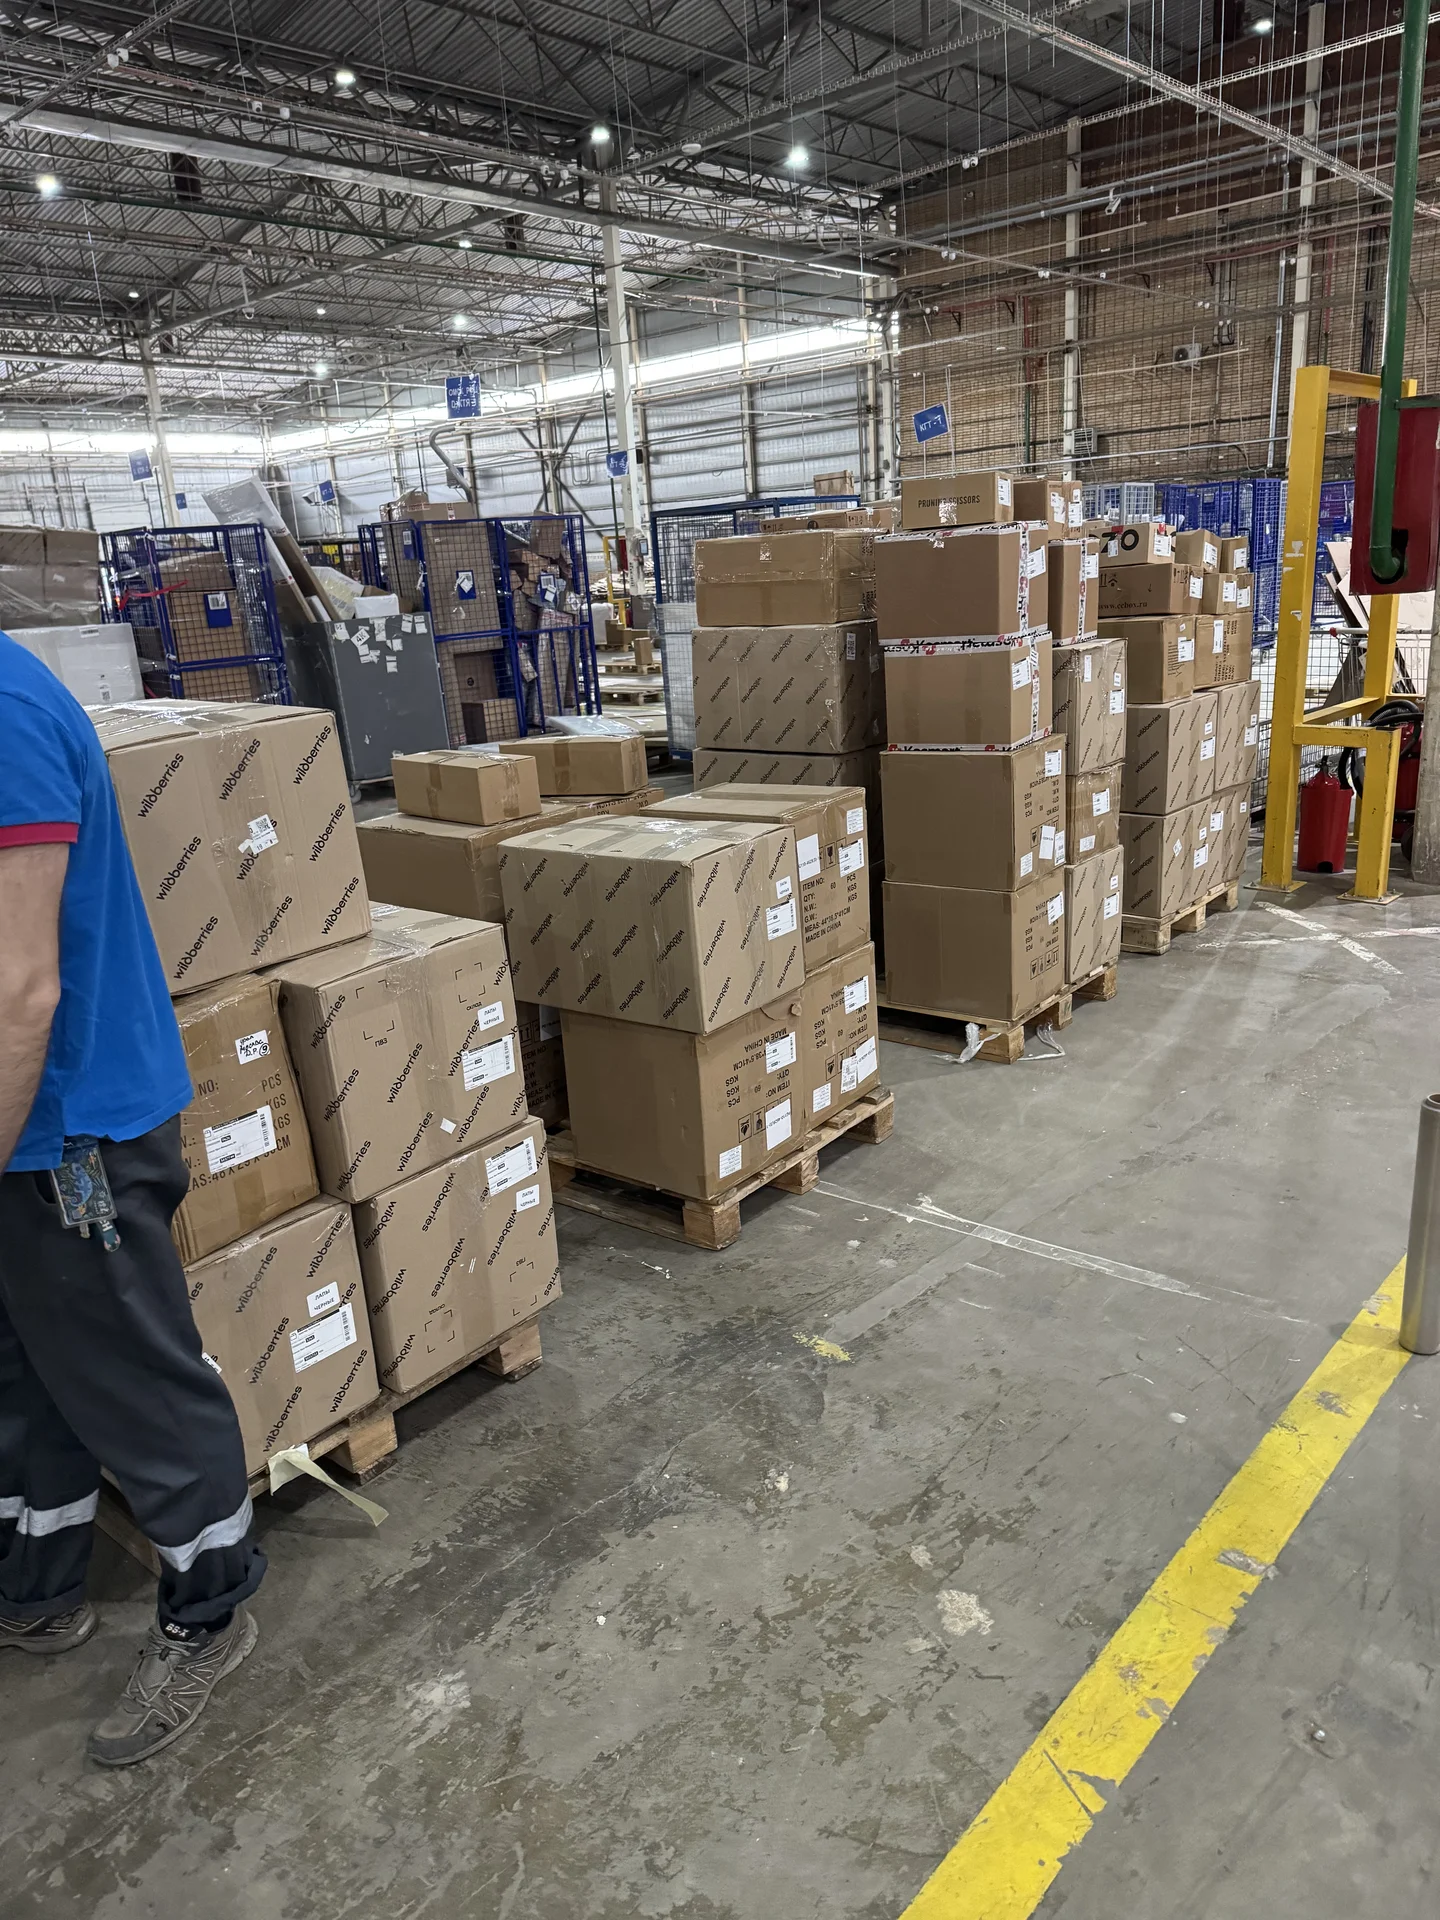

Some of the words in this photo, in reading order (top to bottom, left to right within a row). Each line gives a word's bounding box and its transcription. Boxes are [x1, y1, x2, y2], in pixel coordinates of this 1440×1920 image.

[219, 738, 260, 801] wildberries
[292, 725, 331, 785] wildberries
[138, 752, 184, 818] wildberries
[309, 802, 346, 862] wildberries
[156, 836, 202, 901] wildberries
[524, 856, 548, 892] wildberries
[562, 861, 590, 897] wildberries
[734, 849, 756, 894] wildberries
[769, 836, 787, 880] wildberries
[847, 873, 856, 883] PCS
[321, 876, 359, 936] wildberries
[605, 865, 632, 902] wildberries
[697, 861, 720, 907] wildberries
[803, 880, 815, 891] ITEM
[815, 877, 825, 885] NO:
[804, 893, 815, 902] QTY:
[847, 883, 857, 892] KGS
[848, 893, 857, 902] KGS
[174, 915, 218, 980] wildberries
[250, 894, 292, 958] wildberries
[530, 913, 553, 946] wildberries
[569, 918, 595, 952] wildberries
[612, 923, 638, 958] wildberries
[656, 929, 685, 964] wildberries
[703, 919, 726, 966] wildberries
[740, 905, 761, 950] wildberries
[805, 922, 820, 933] MEAS:
[805, 933, 820, 943] MADE
[827, 921, 842, 932] CHINA
[537, 966, 560, 997] wildberries
[577, 972, 602, 1004] wildberries
[744, 960, 765, 1005] wildberries
[777, 945, 796, 989] wildberries
[619, 979, 645, 1012] wildberries
[662, 987, 690, 1020] wildberries
[708, 976, 731, 1023] wildberries
[310, 993, 346, 1049] wildberries
[814, 1019, 824, 1030] KGS
[815, 1028, 825, 1040] KGS
[744, 1041, 763, 1053] CHINA
[816, 1039, 826, 1049] PCS
[198, 1078, 220, 1096] NO:
[261, 1074, 282, 1092] PCS
[323, 1067, 360, 1123] wildberries
[386, 1042, 423, 1104] wildberries
[726, 1074, 739, 1087] KGS
[727, 1085, 739, 1097] KGS
[776, 1080, 790, 1094] ITEM
[457, 1085, 490, 1144] wildberries
[728, 1096, 741, 1108] PCS
[397, 1111, 434, 1173] wildberries
[336, 1139, 371, 1193] wildberries
[422, 1172, 456, 1232] wildberries
[306, 1213, 346, 1278] wildberries
[364, 1201, 397, 1250] wildberries
[488, 1209, 517, 1266] wildberries
[235, 1246, 278, 1314] wildberries
[431, 1237, 465, 1298] wildberries
[372, 1268, 407, 1316] wildberries
[249, 1316, 289, 1385] wildberries
[383, 1334, 416, 1378] wildberries
[329, 1349, 368, 1413] wildberries
[263, 1386, 302, 1453] wildberries
